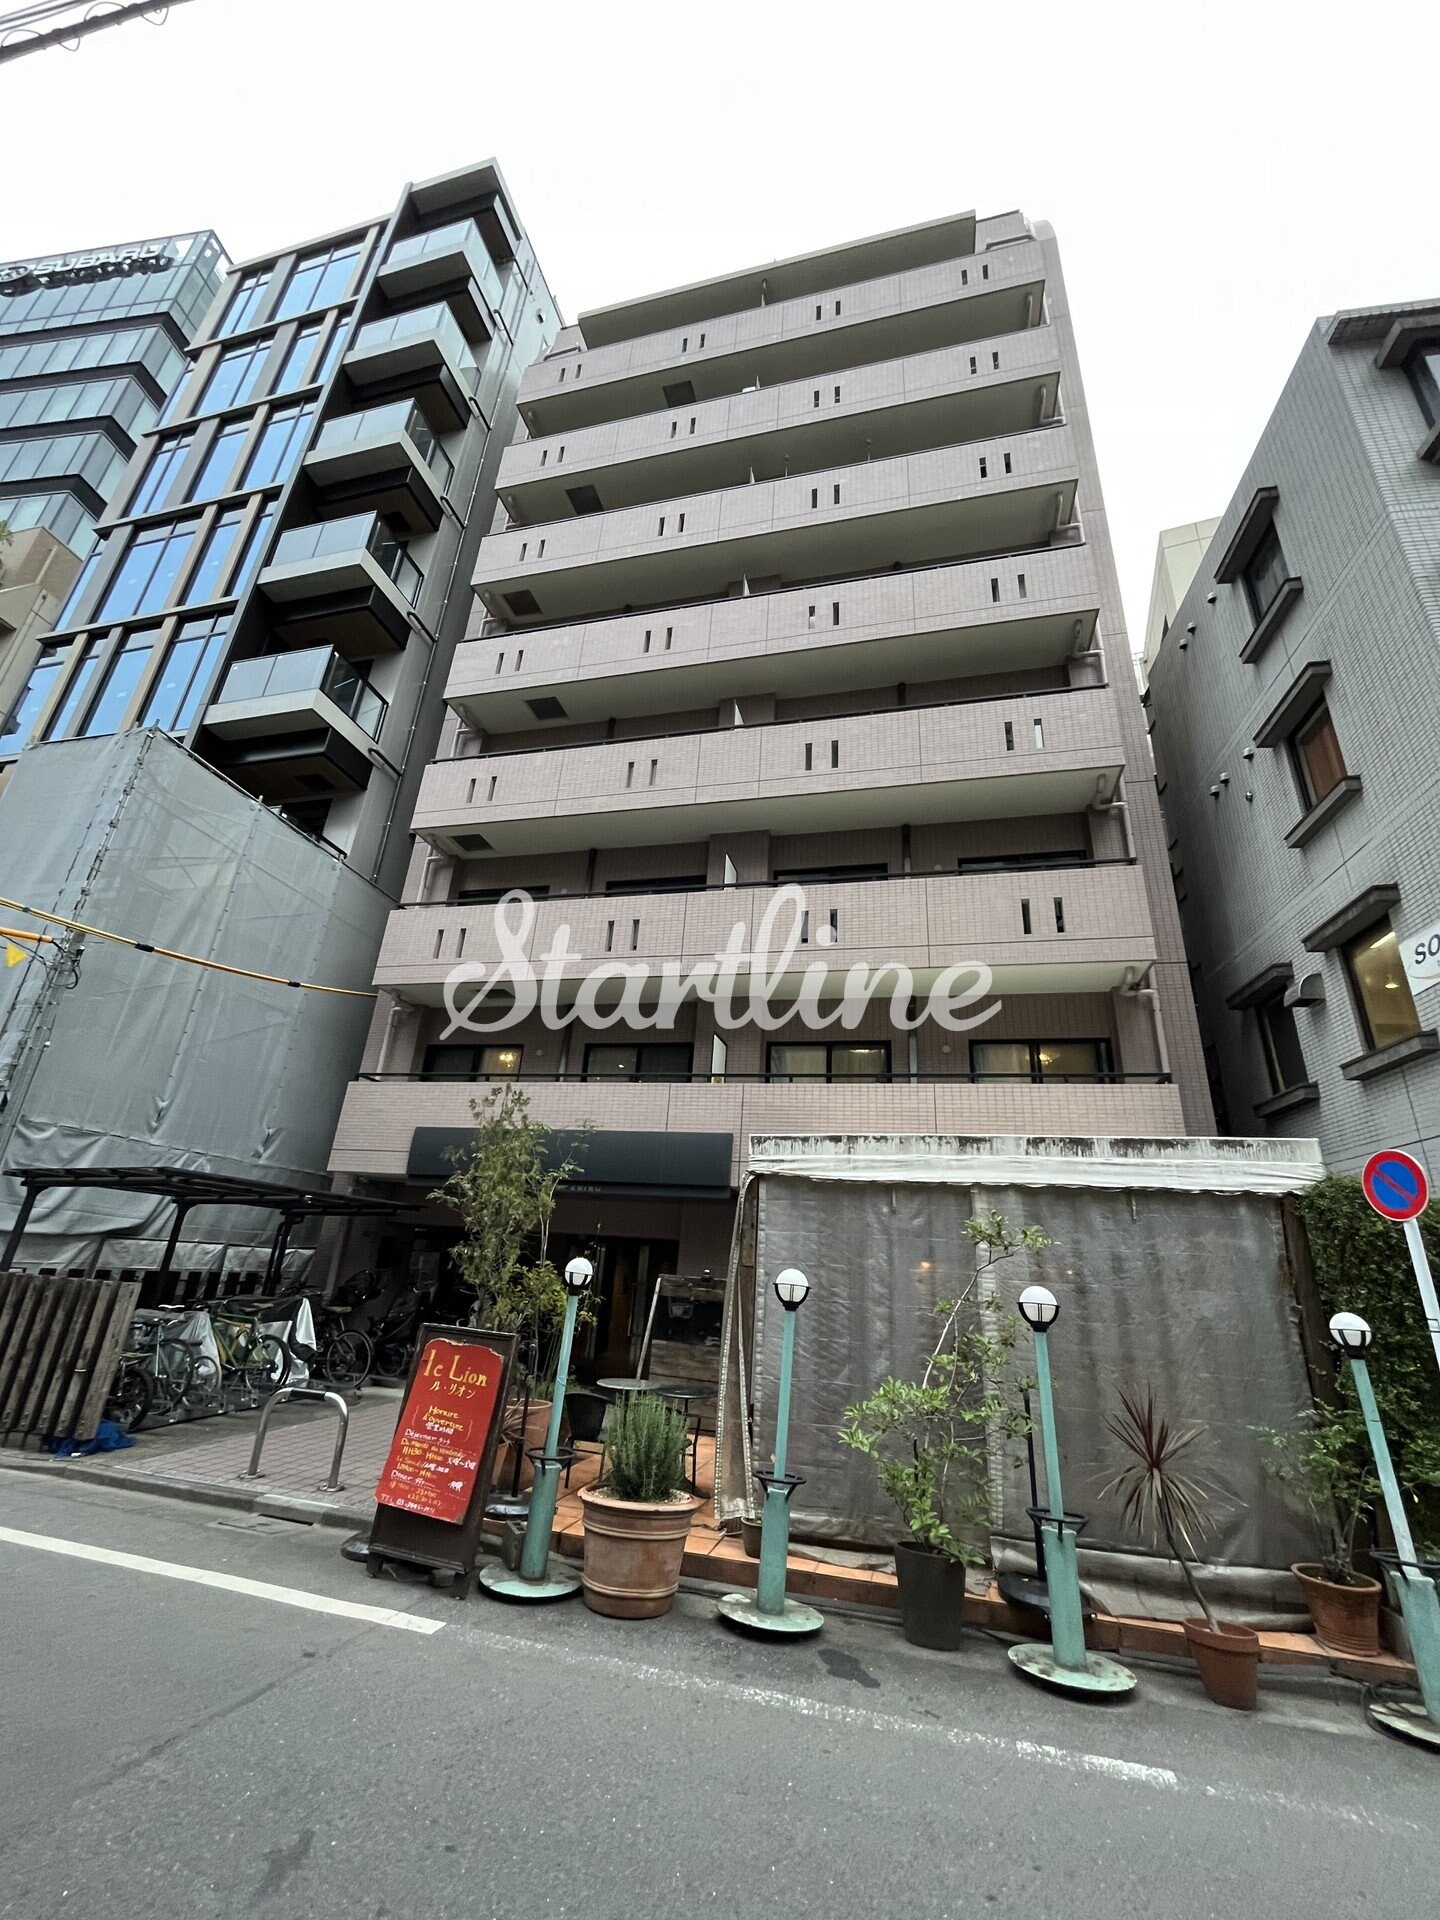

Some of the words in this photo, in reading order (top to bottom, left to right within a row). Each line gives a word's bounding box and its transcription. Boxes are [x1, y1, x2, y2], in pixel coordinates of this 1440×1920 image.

[33, 244, 164, 275] SUBARU
[423, 1349, 444, 1377] le
[449, 1354, 488, 1388] Lion
[429, 1380, 476, 1400] ル・リオン
[428, 1404, 460, 1419] Horaire
